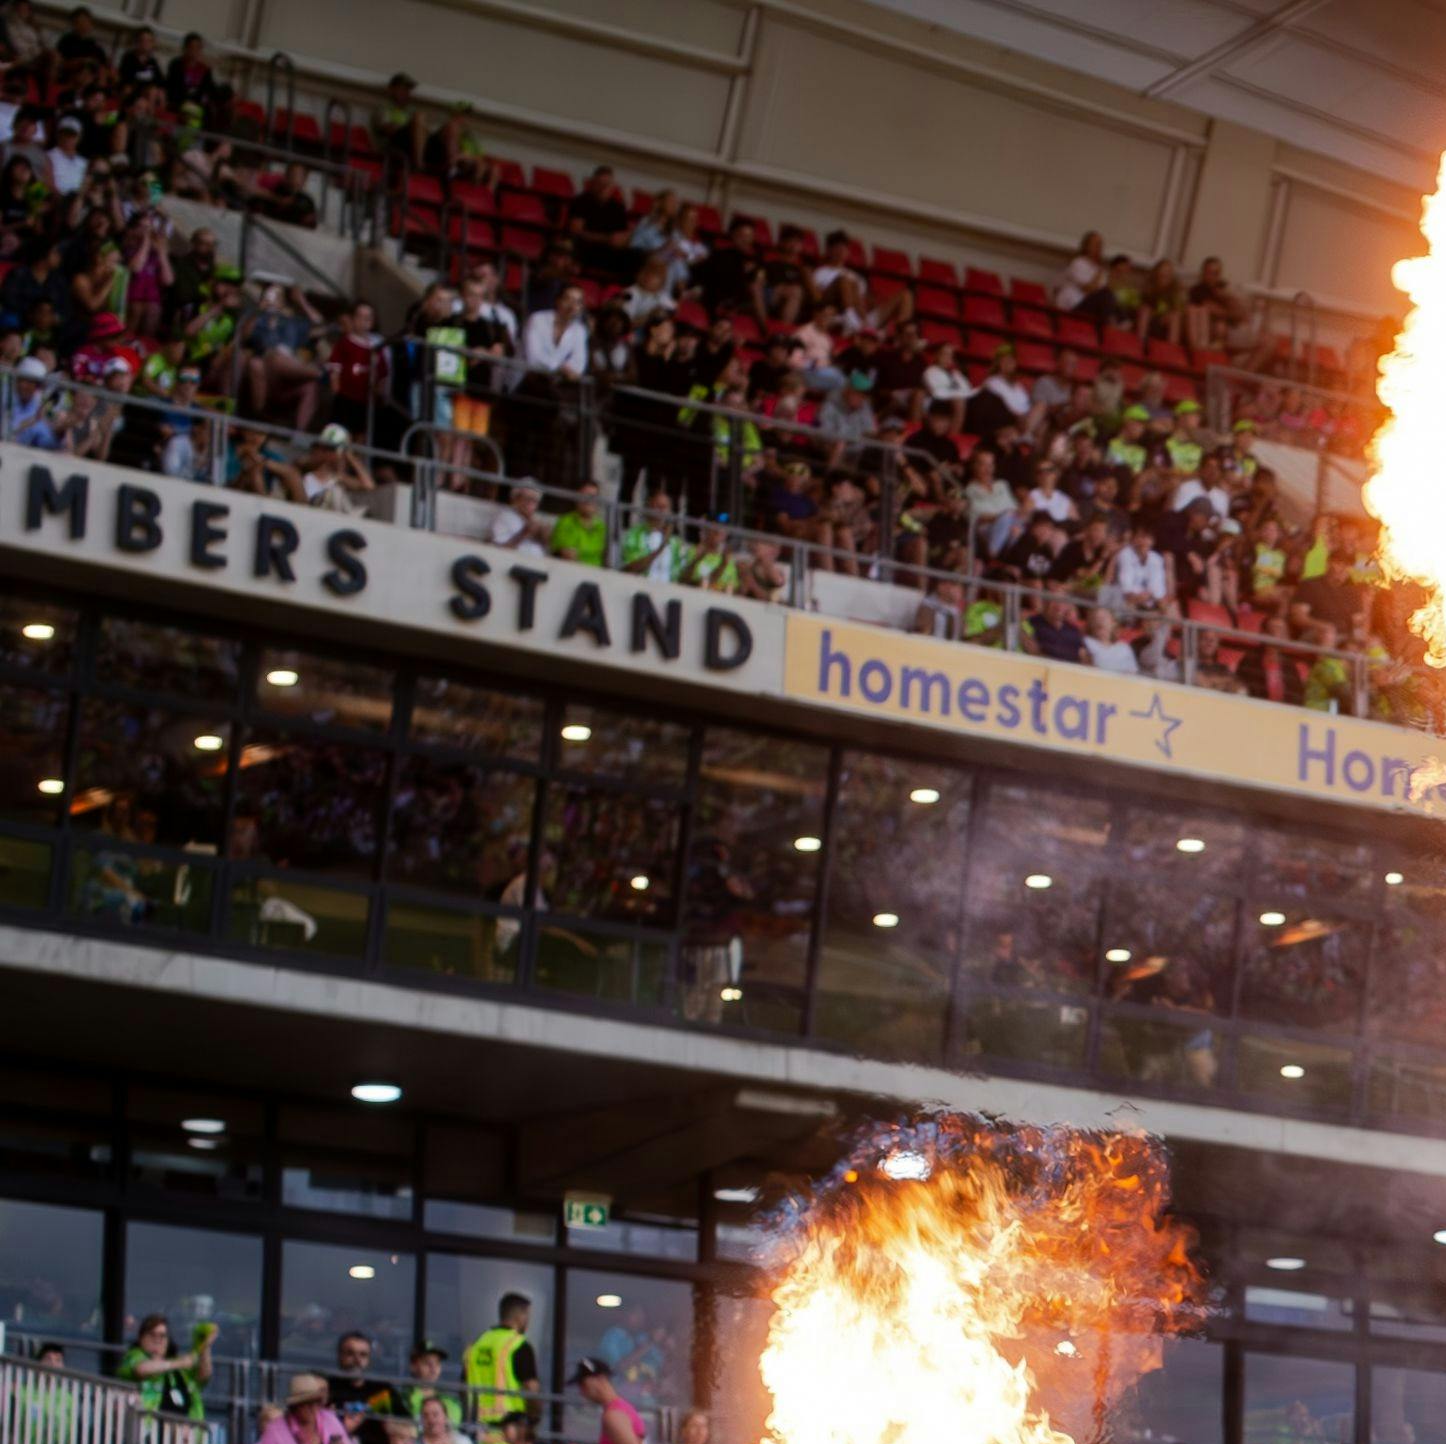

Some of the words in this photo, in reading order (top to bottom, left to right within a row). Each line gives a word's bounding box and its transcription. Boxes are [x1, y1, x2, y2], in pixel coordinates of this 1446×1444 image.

[0, 456, 368, 597] MBERS
[450, 555, 753, 671] STAND
[818, 630, 1118, 745] homestar
